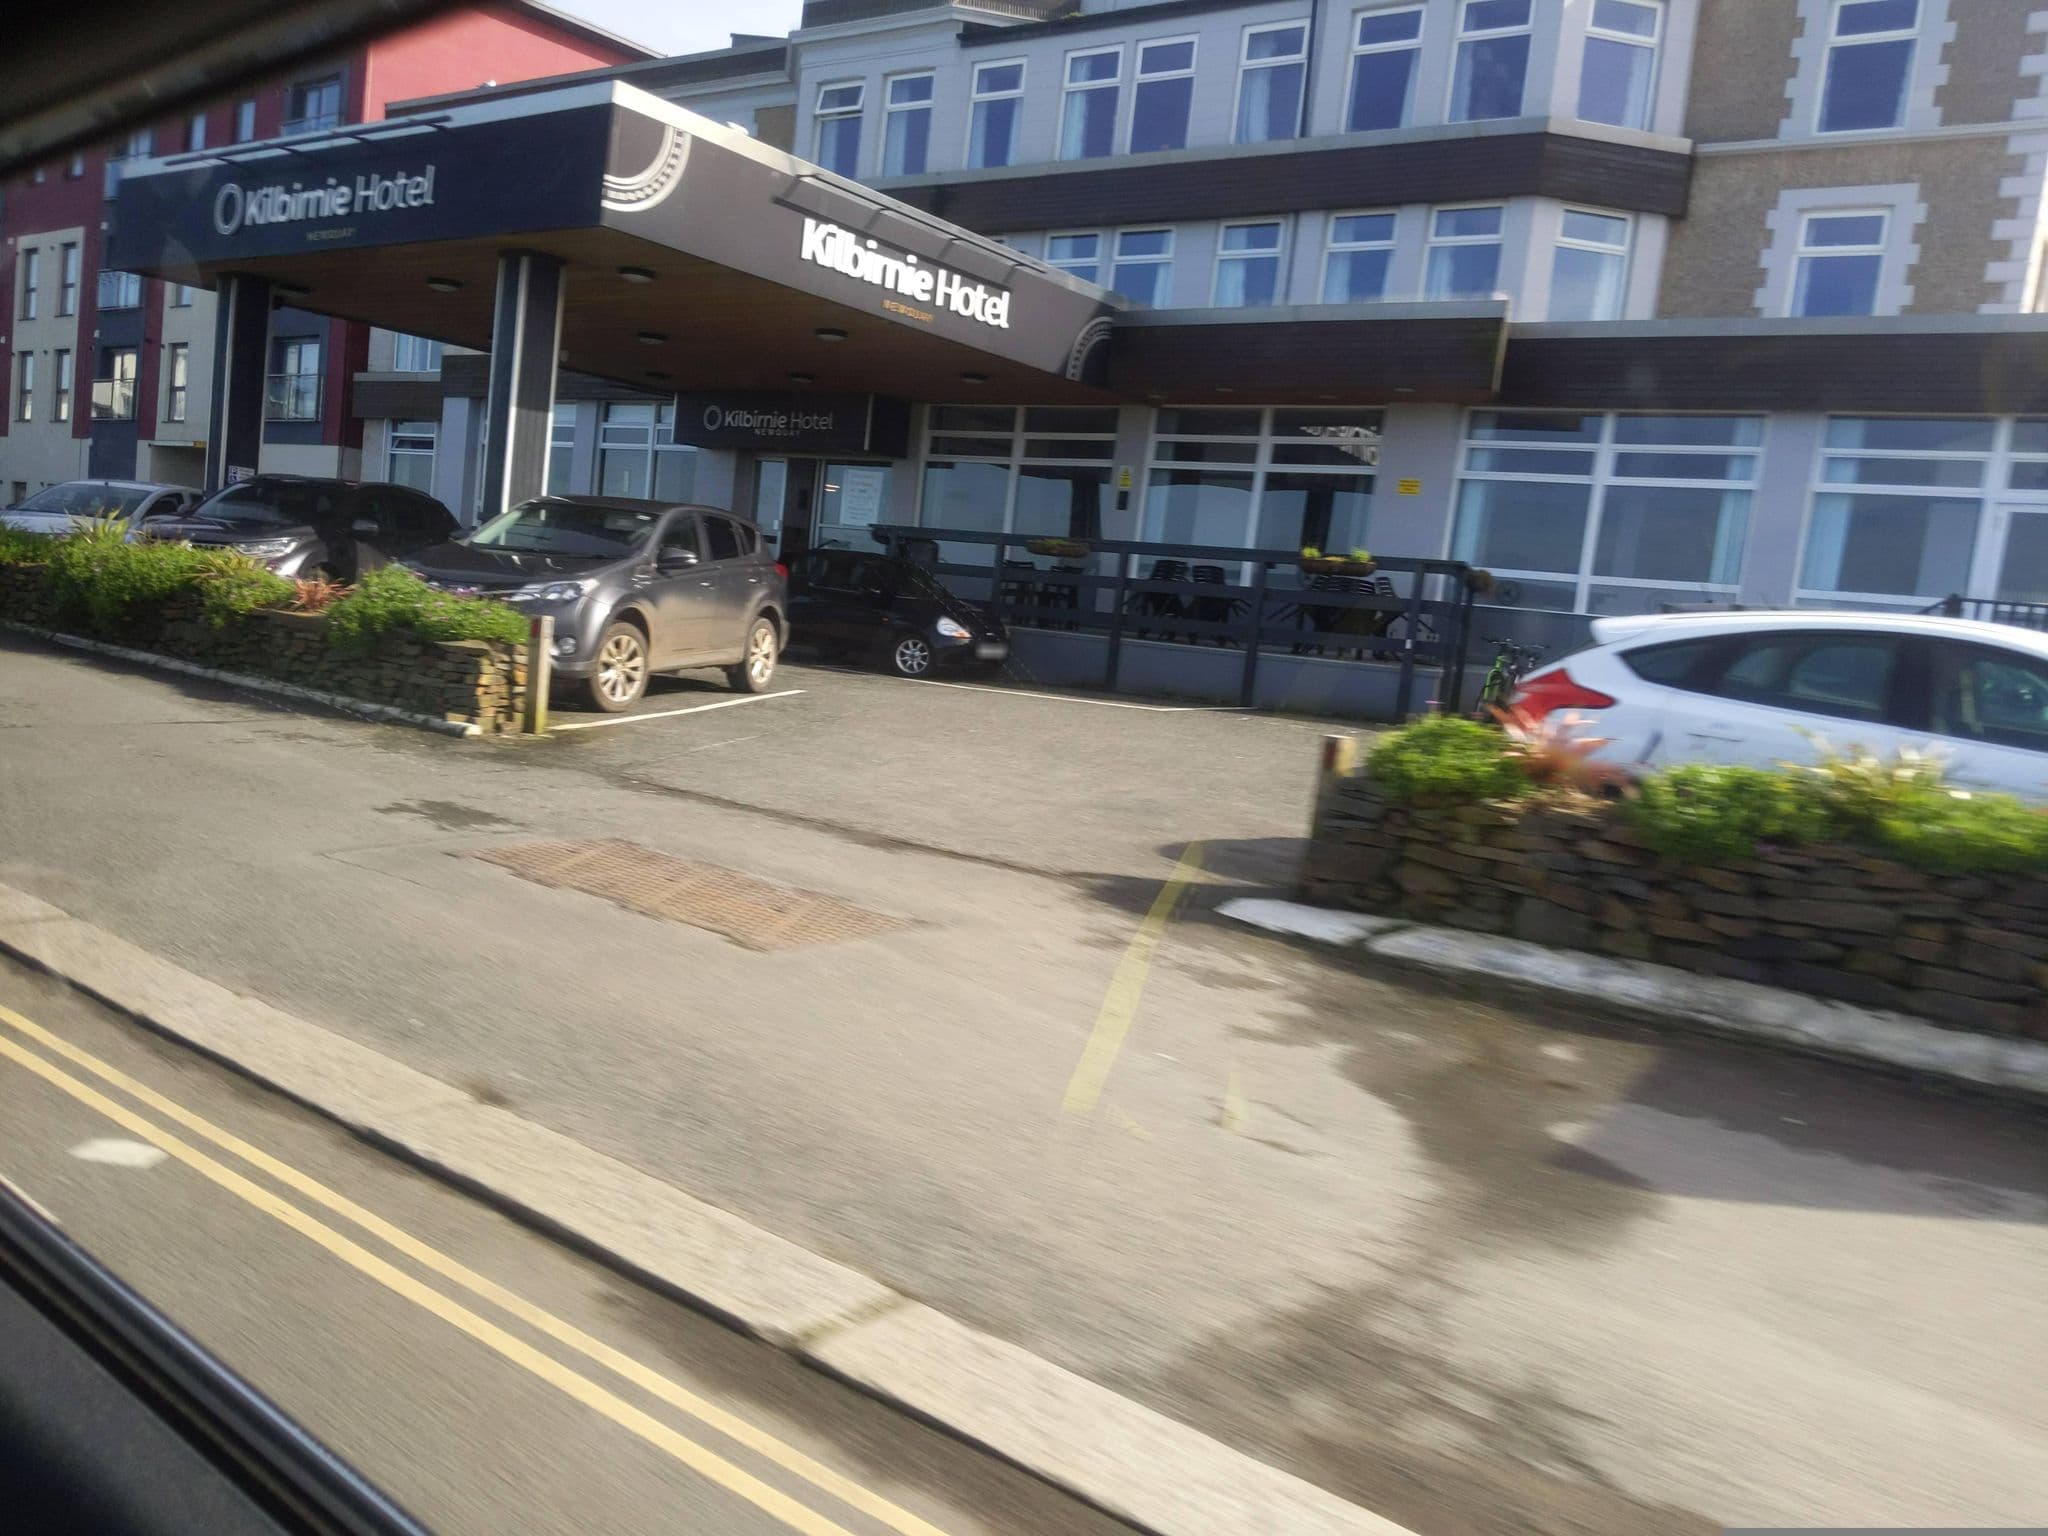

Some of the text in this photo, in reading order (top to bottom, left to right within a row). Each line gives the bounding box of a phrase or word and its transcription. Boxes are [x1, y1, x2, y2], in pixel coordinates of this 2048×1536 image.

[244, 164, 436, 226] Kilbirnie Hotel
[801, 217, 1011, 329] Kilbirnie Hotel
[724, 409, 833, 430] Kilbirnie Hotel
